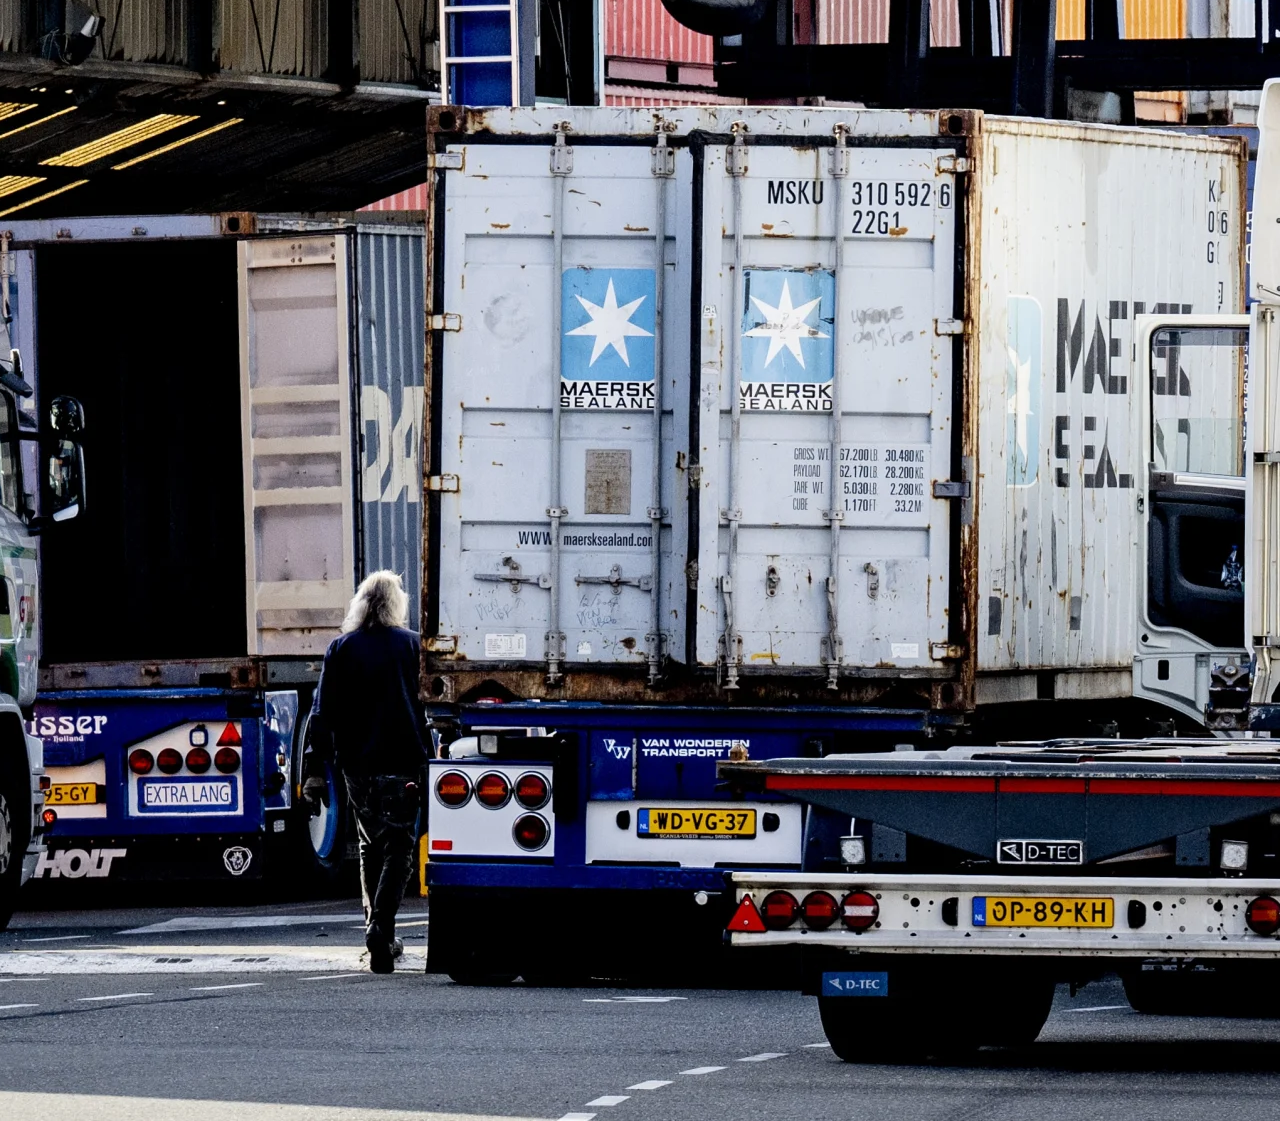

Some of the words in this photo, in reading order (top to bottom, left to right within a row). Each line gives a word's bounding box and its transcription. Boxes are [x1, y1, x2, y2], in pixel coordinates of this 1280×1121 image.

[767, 180, 825, 205] MSKU
[851, 181, 889, 206] 310
[894, 182, 932, 207] 592
[940, 183, 951, 207] 6
[851, 210, 901, 235] 22G1
[560, 381, 655, 397] MAERSK
[739, 383, 833, 399] MAERSK
[559, 396, 655, 409] SEALAND
[794, 447, 815, 461] GROSS
[793, 464, 821, 478] PAYLOAD
[793, 481, 808, 494] TARE
[792, 498, 808, 511] CUBE
[641, 739, 670, 748] VAN
[673, 739, 750, 749] WONDEREN
[641, 748, 723, 757] TRANSPORT
[146, 784, 189, 804] EXTRA
[192, 784, 230, 803] LANG
[656, 812, 749, 831] WD-VG-37
[1027, 844, 1078, 860] D-TEC
[33, 848, 127, 879] HOLT
[974, 913, 985, 921] NL
[992, 900, 1106, 923] OP-89-KH
[845, 979, 881, 990] D-TEC
